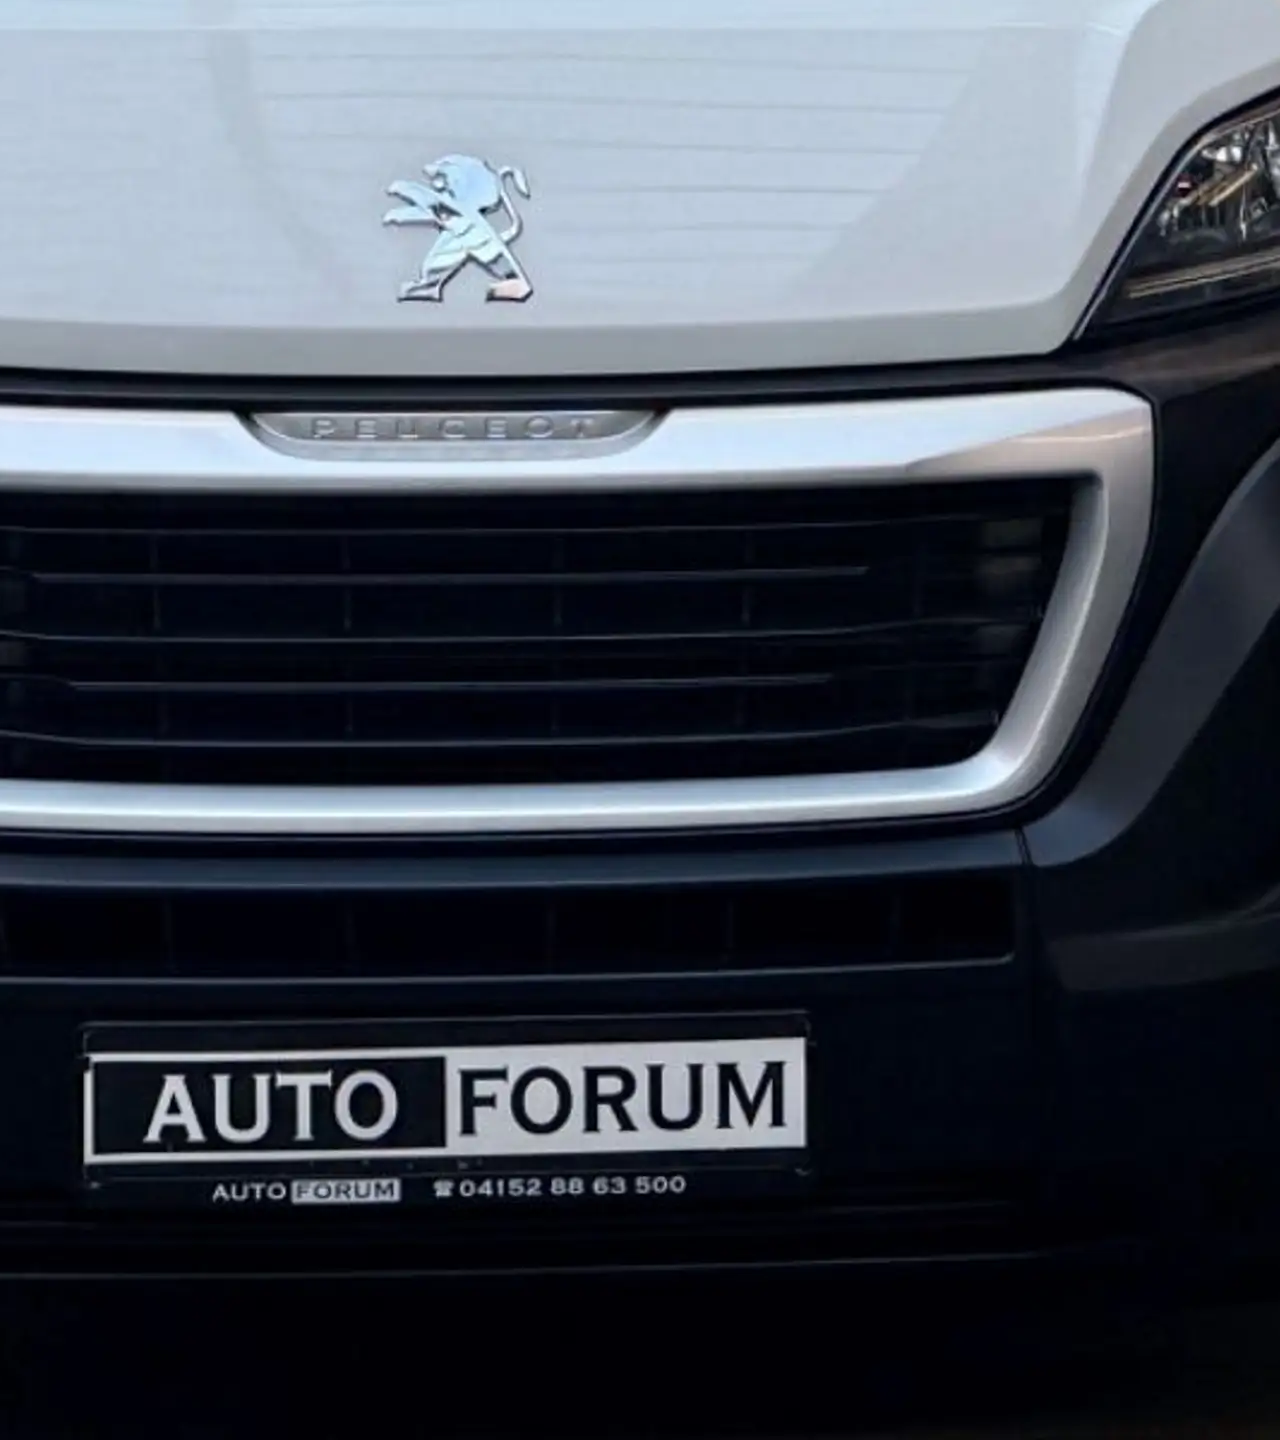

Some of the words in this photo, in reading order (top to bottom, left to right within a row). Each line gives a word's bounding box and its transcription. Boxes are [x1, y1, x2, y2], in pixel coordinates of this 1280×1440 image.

[309, 414, 596, 440] PEUGEOT
[142, 1070, 399, 1144] AUTO
[458, 1060, 788, 1137] FORUM
[212, 1181, 287, 1202] AUTO
[296, 1179, 395, 1200] FORUM
[459, 1178, 542, 1197] 04152
[550, 1176, 585, 1195] 88
[592, 1176, 627, 1195] 63
[634, 1175, 687, 1194] 500
